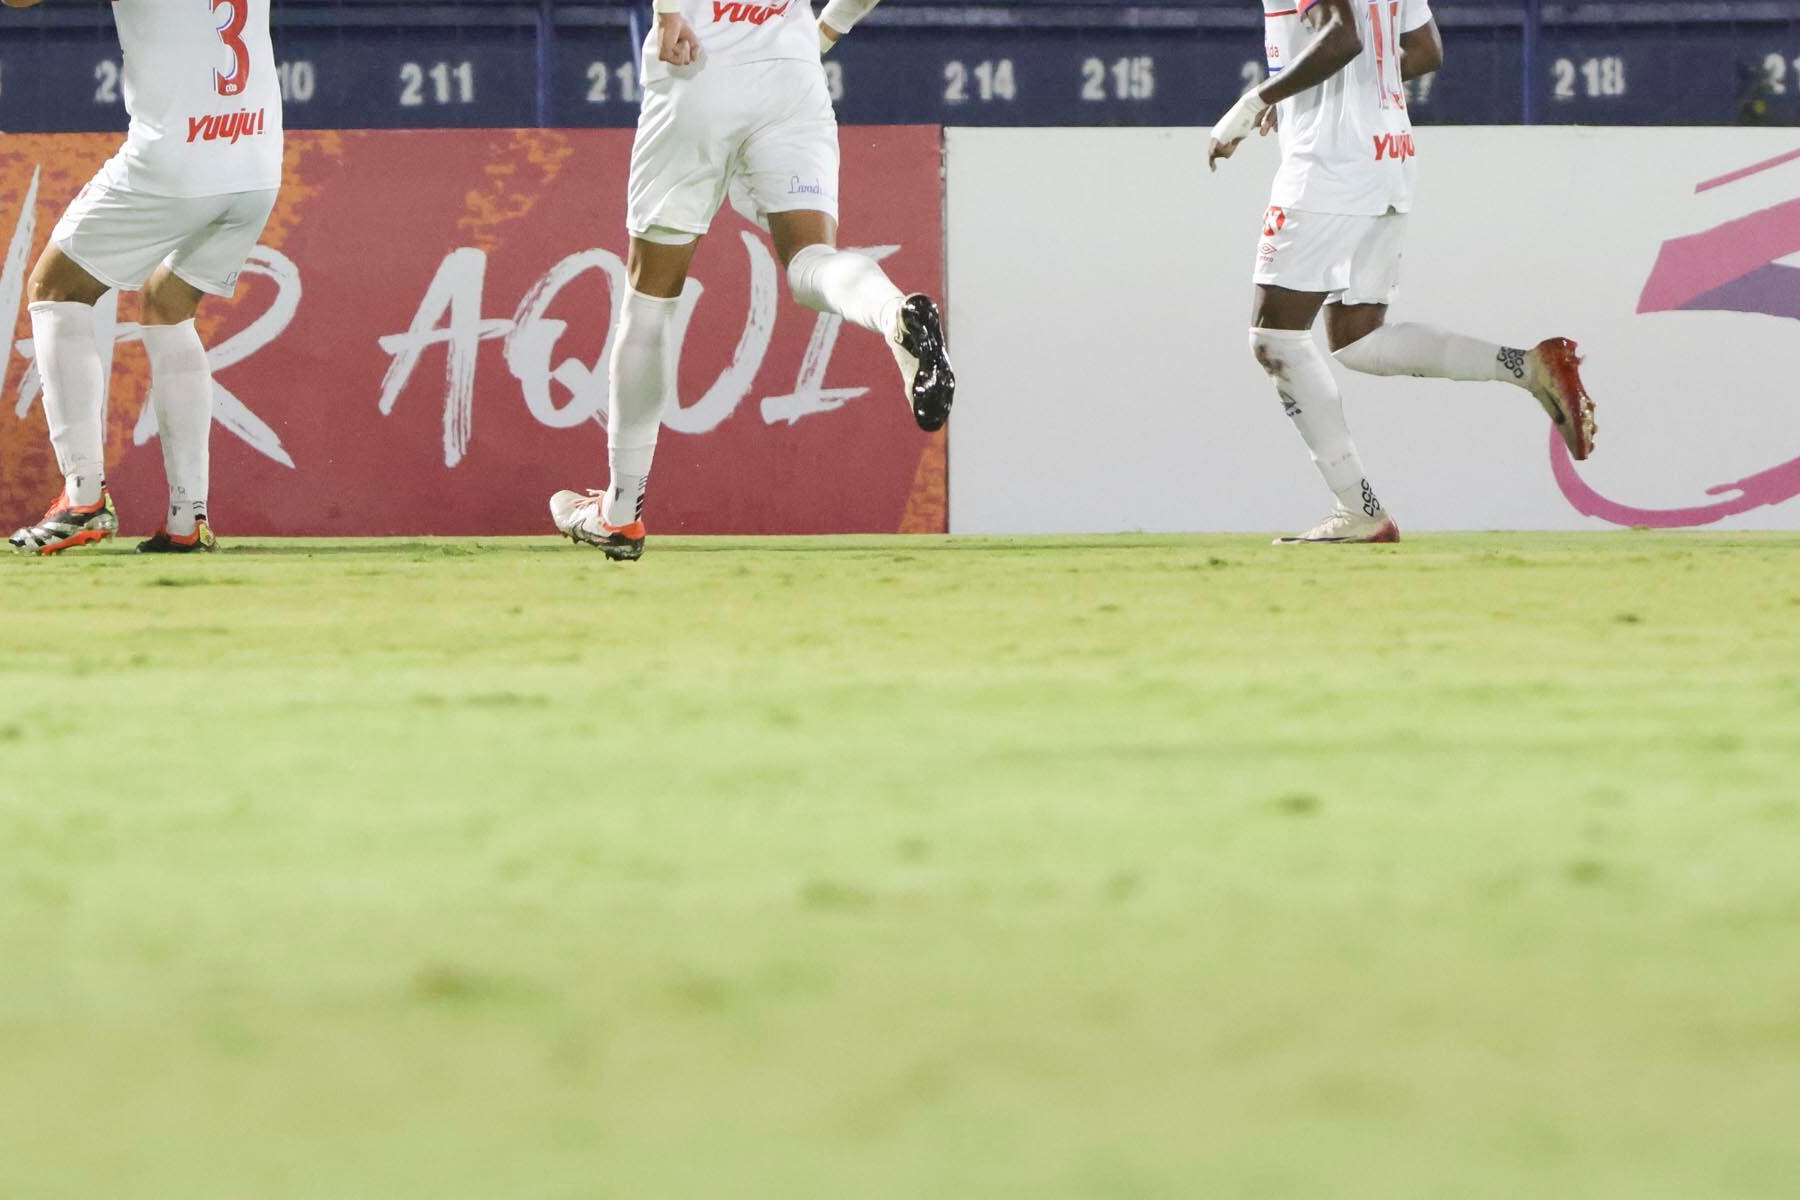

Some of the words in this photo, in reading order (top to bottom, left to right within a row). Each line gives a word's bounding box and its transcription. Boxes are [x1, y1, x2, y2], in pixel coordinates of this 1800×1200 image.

[399, 62, 474, 106] 211
[943, 59, 1016, 101] 214
[1081, 57, 1155, 100] 215
[1554, 57, 1626, 97] 218
